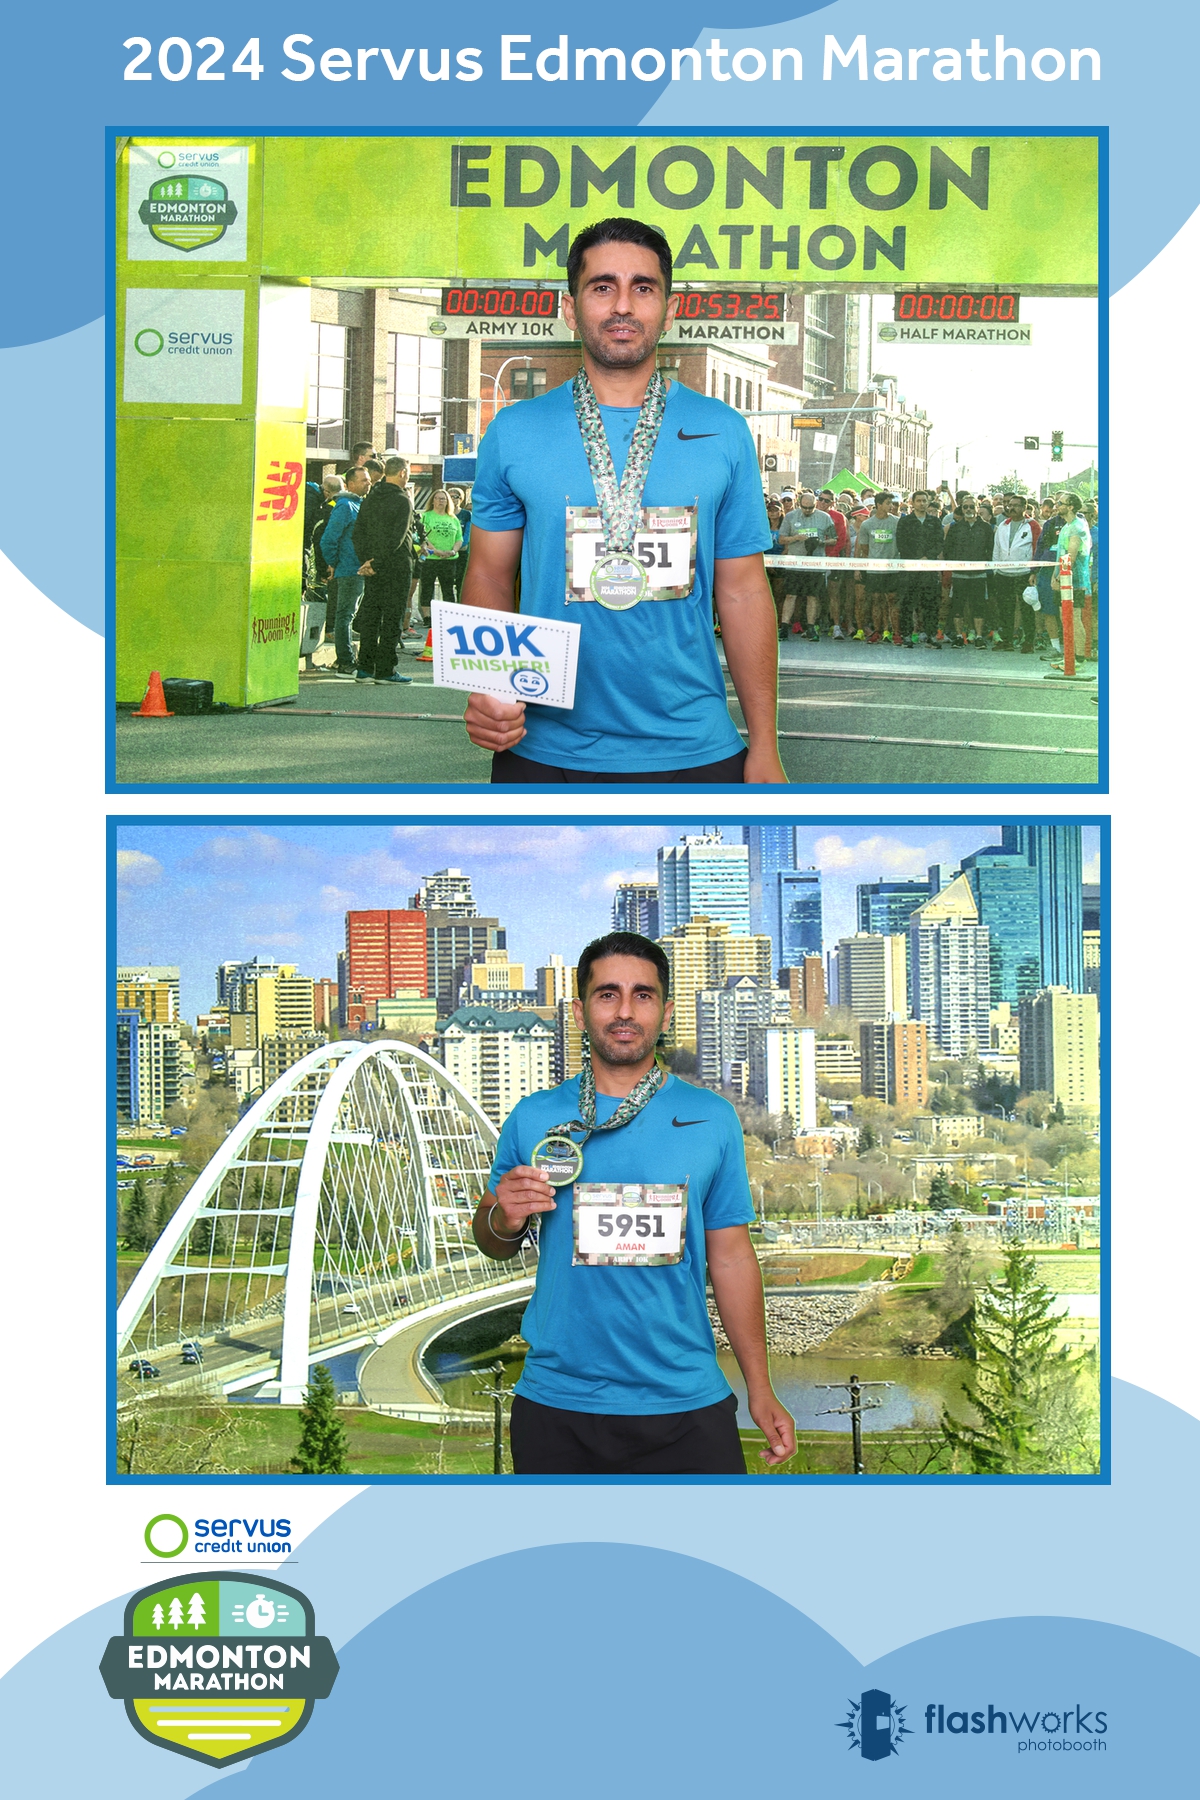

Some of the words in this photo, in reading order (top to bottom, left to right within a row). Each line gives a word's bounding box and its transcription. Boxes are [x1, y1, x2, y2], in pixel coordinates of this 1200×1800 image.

[178, 152, 220, 161] servus
[451, 145, 990, 211] EDMONTON
[149, 203, 227, 214] EDMONTON
[160, 214, 215, 222] MARATHON
[523, 223, 907, 271] MATHON
[465, 321, 518, 335] ARMY
[522, 322, 554, 336] 10K
[679, 325, 785, 340] MARATHON
[900, 328, 939, 340] HALF
[942, 329, 1031, 341] MARATHON
[168, 331, 233, 345] servus
[168, 345, 200, 355] credit
[203, 347, 233, 355] union
[258, 613, 290, 635] Running
[446, 625, 545, 657] 10K
[450, 658, 551, 673] FINISHER!
[598, 1214, 665, 1237] 5951
[615, 1243, 646, 1251] AMAN
